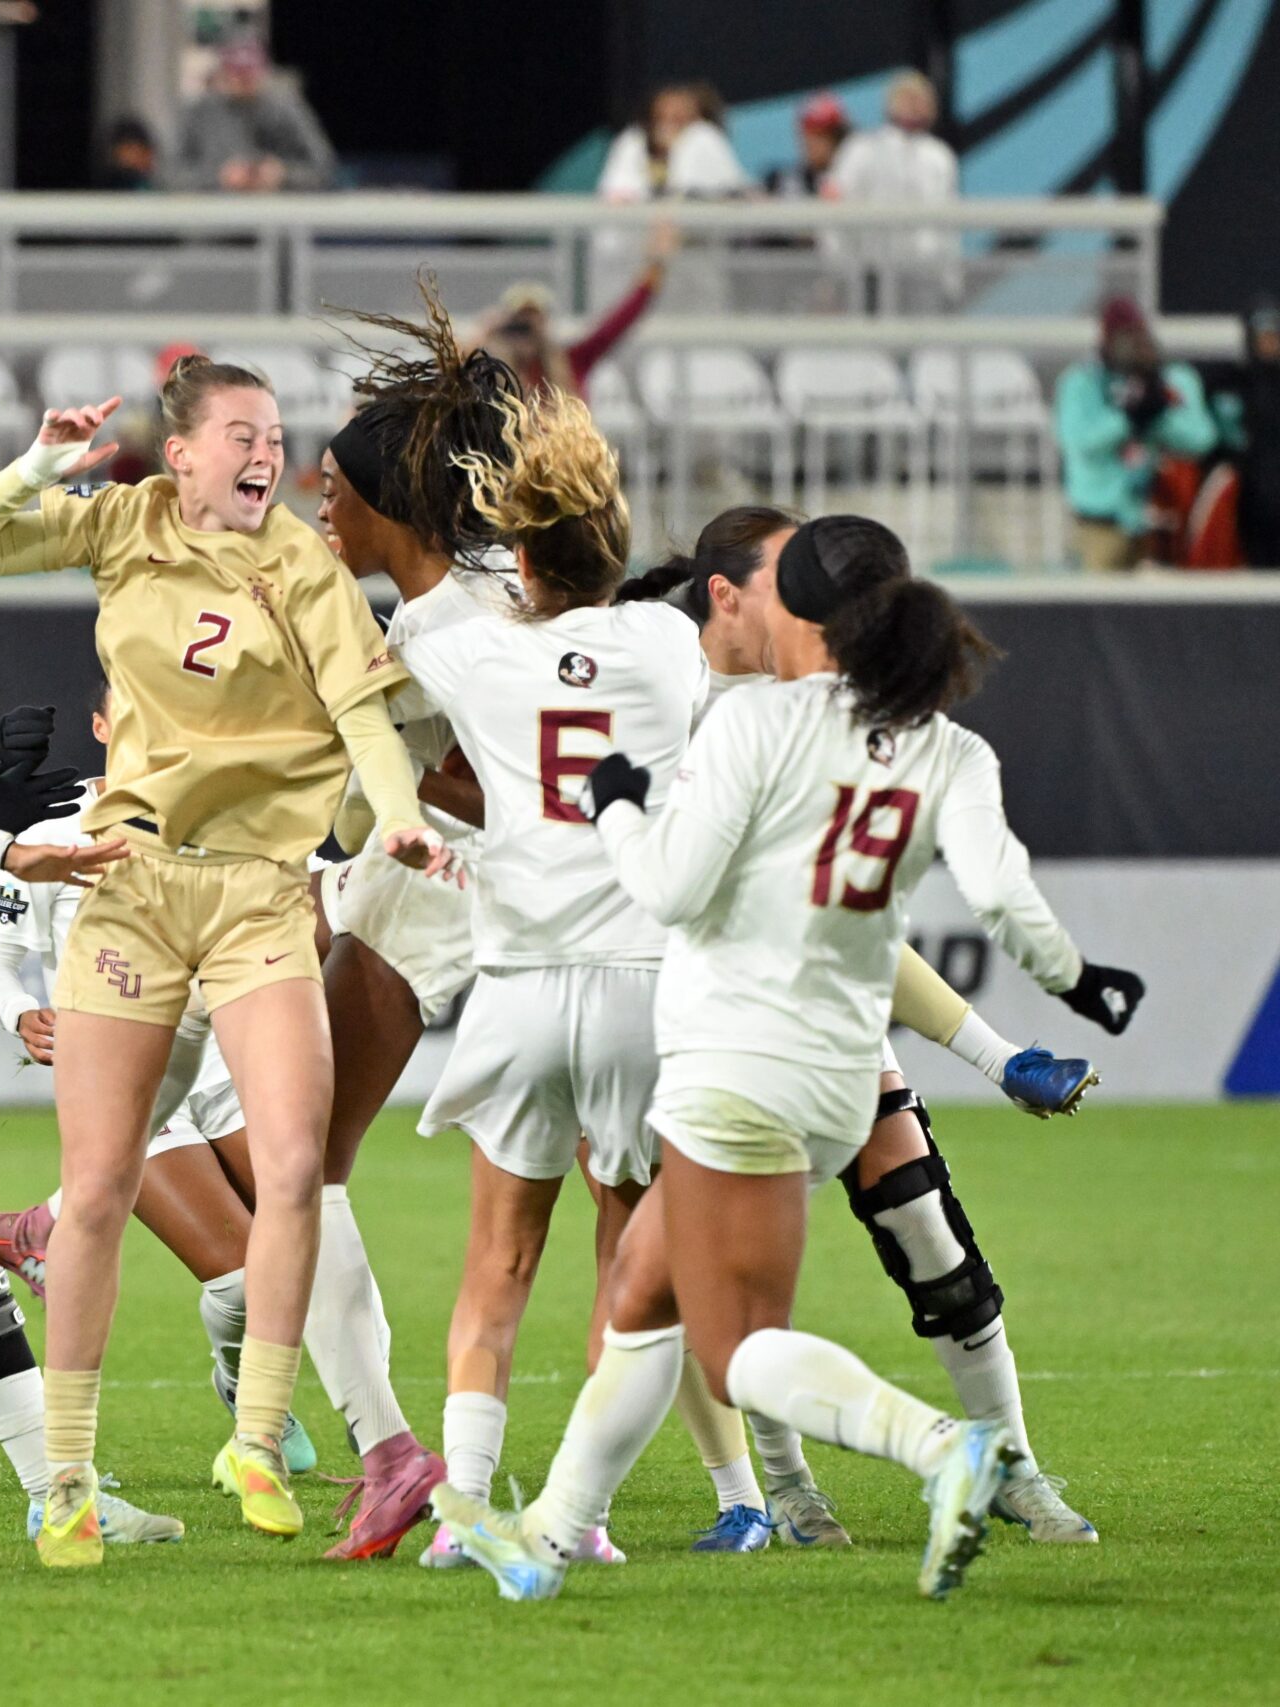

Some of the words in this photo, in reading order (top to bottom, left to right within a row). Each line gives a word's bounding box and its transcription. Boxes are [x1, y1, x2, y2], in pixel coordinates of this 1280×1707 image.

[181, 609, 233, 680] 2
[810, 780, 922, 914] 19
[96, 948, 142, 999] FSU
